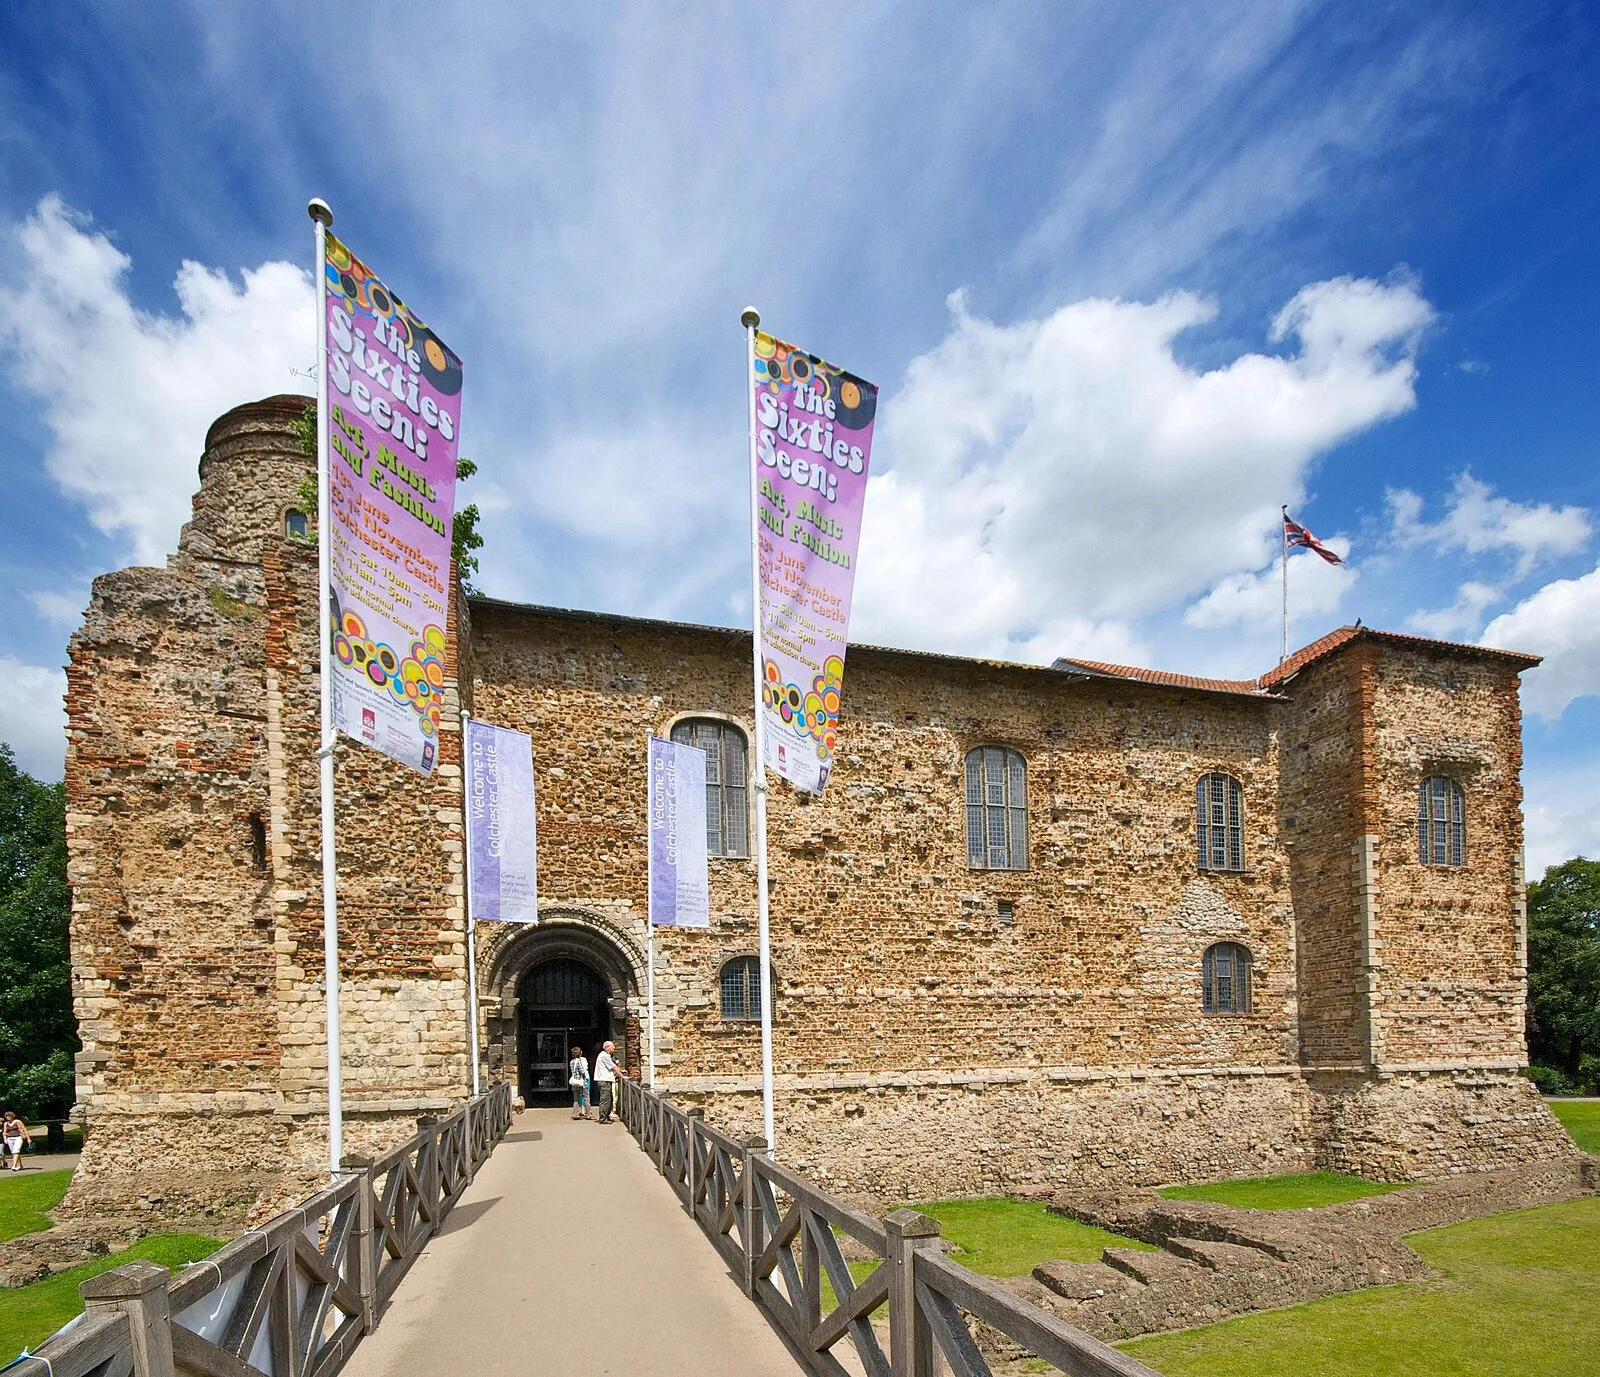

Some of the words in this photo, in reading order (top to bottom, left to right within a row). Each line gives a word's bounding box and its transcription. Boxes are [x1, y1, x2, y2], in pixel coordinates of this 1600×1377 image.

[372, 309, 421, 373] The
[329, 304, 454, 441] Sixties
[792, 380, 836, 420] The
[329, 347, 428, 460] Seen:
[757, 392, 864, 474] Sixties
[331, 402, 369, 457] Art,
[376, 442, 437, 503] Music
[758, 429, 838, 502] Seen:
[331, 430, 363, 478] and
[369, 463, 446, 538] Fashion
[356, 493, 390, 525] June
[759, 476, 790, 518] Art,
[796, 499, 843, 540] Music
[331, 480, 344, 502] to
[363, 512, 439, 574] November
[331, 496, 399, 564] Colchester
[402, 556, 445, 594] Castle
[759, 504, 784, 536] and
[790, 523, 850, 569] Fashion
[346, 556, 376, 586] 11am
[387, 584, 412, 609] 5pm
[359, 551, 378, 572] Sat
[381, 566, 411, 593] 10am
[422, 592, 444, 614] 5pm
[776, 549, 806, 572] June
[784, 567, 842, 606] November
[350, 588, 390, 619] admission
[392, 616, 419, 636] charge
[365, 589, 394, 611] normal
[759, 563, 808, 607] Colchester
[810, 599, 846, 624] Castle
[781, 637, 802, 652] normal
[795, 613, 816, 632] 10am
[825, 628, 845, 644] 5pm
[797, 630, 816, 645] 5pm
[472, 742, 483, 755] to
[484, 745, 498, 785] Castle
[654, 758, 664, 771] to
[472, 759, 485, 819] Welcome
[652, 774, 665, 829] Welcome
[665, 760, 676, 798] Castle
[487, 787, 500, 858] Colchester
[666, 801, 677, 866] Colchester
